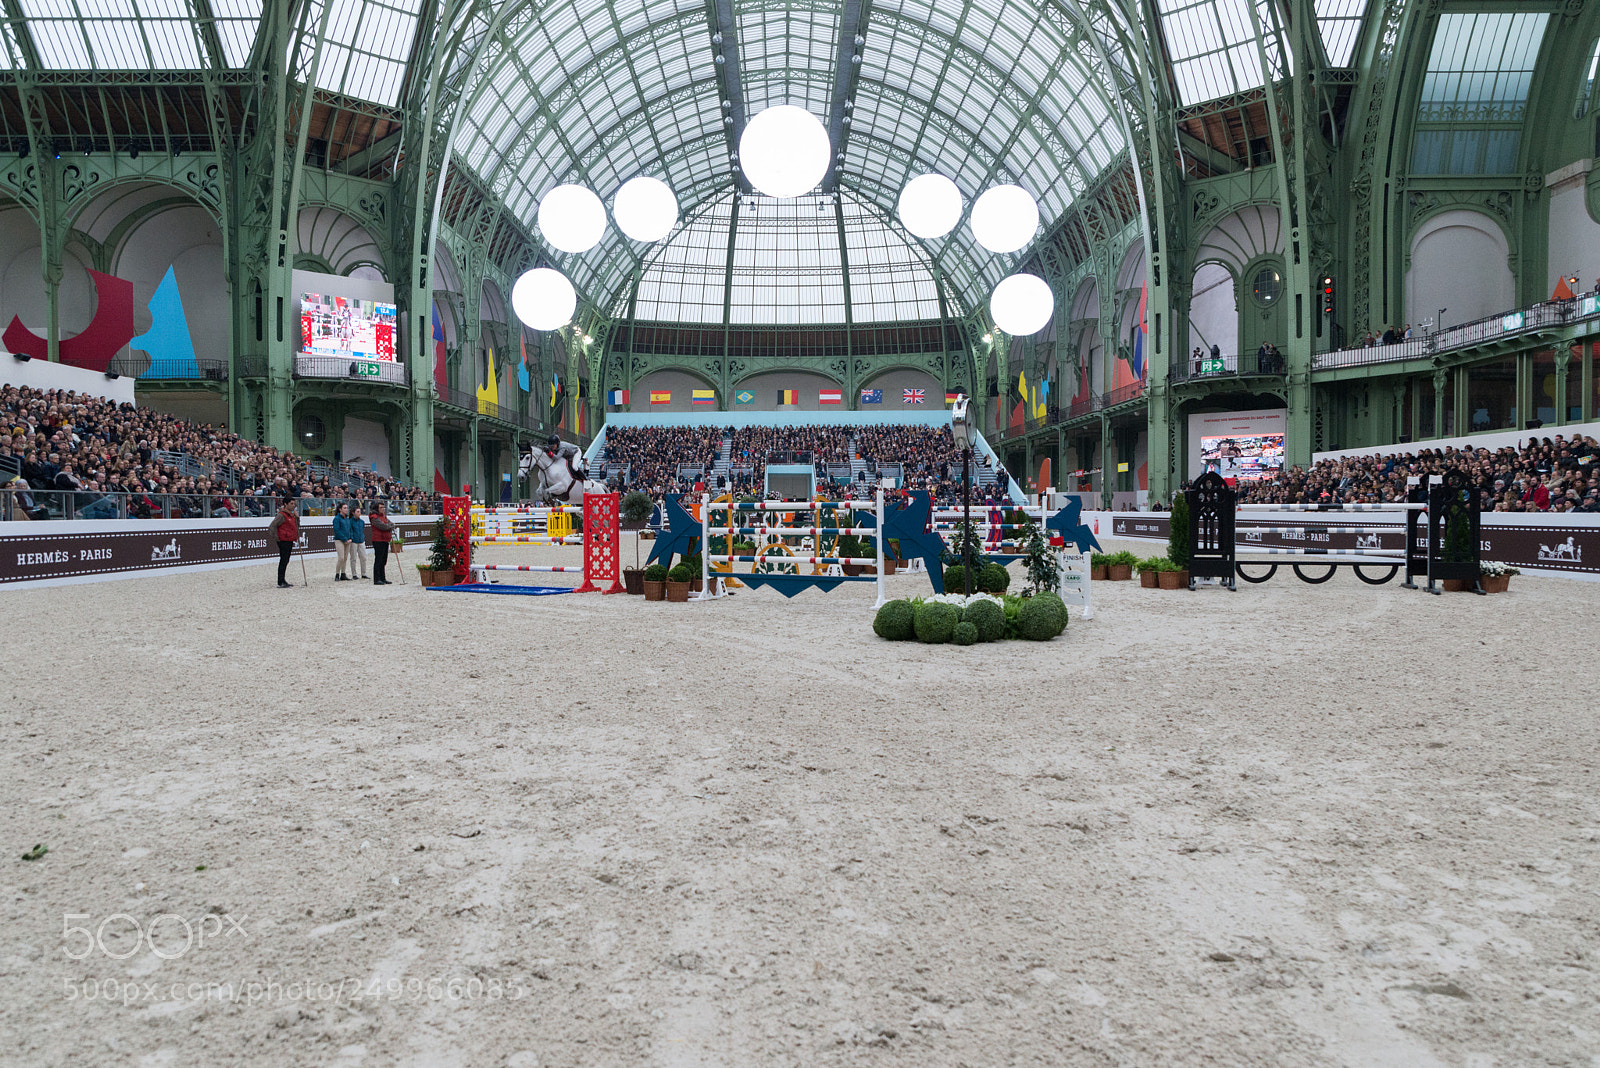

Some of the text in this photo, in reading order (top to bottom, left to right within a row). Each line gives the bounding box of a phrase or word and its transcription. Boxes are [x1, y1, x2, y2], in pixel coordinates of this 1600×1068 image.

[1310, 533, 1330, 542] PARIS
[247, 539, 267, 549] PARIS
[17, 549, 69, 565] HERMÈS
[80, 548, 112, 561] PARIS
